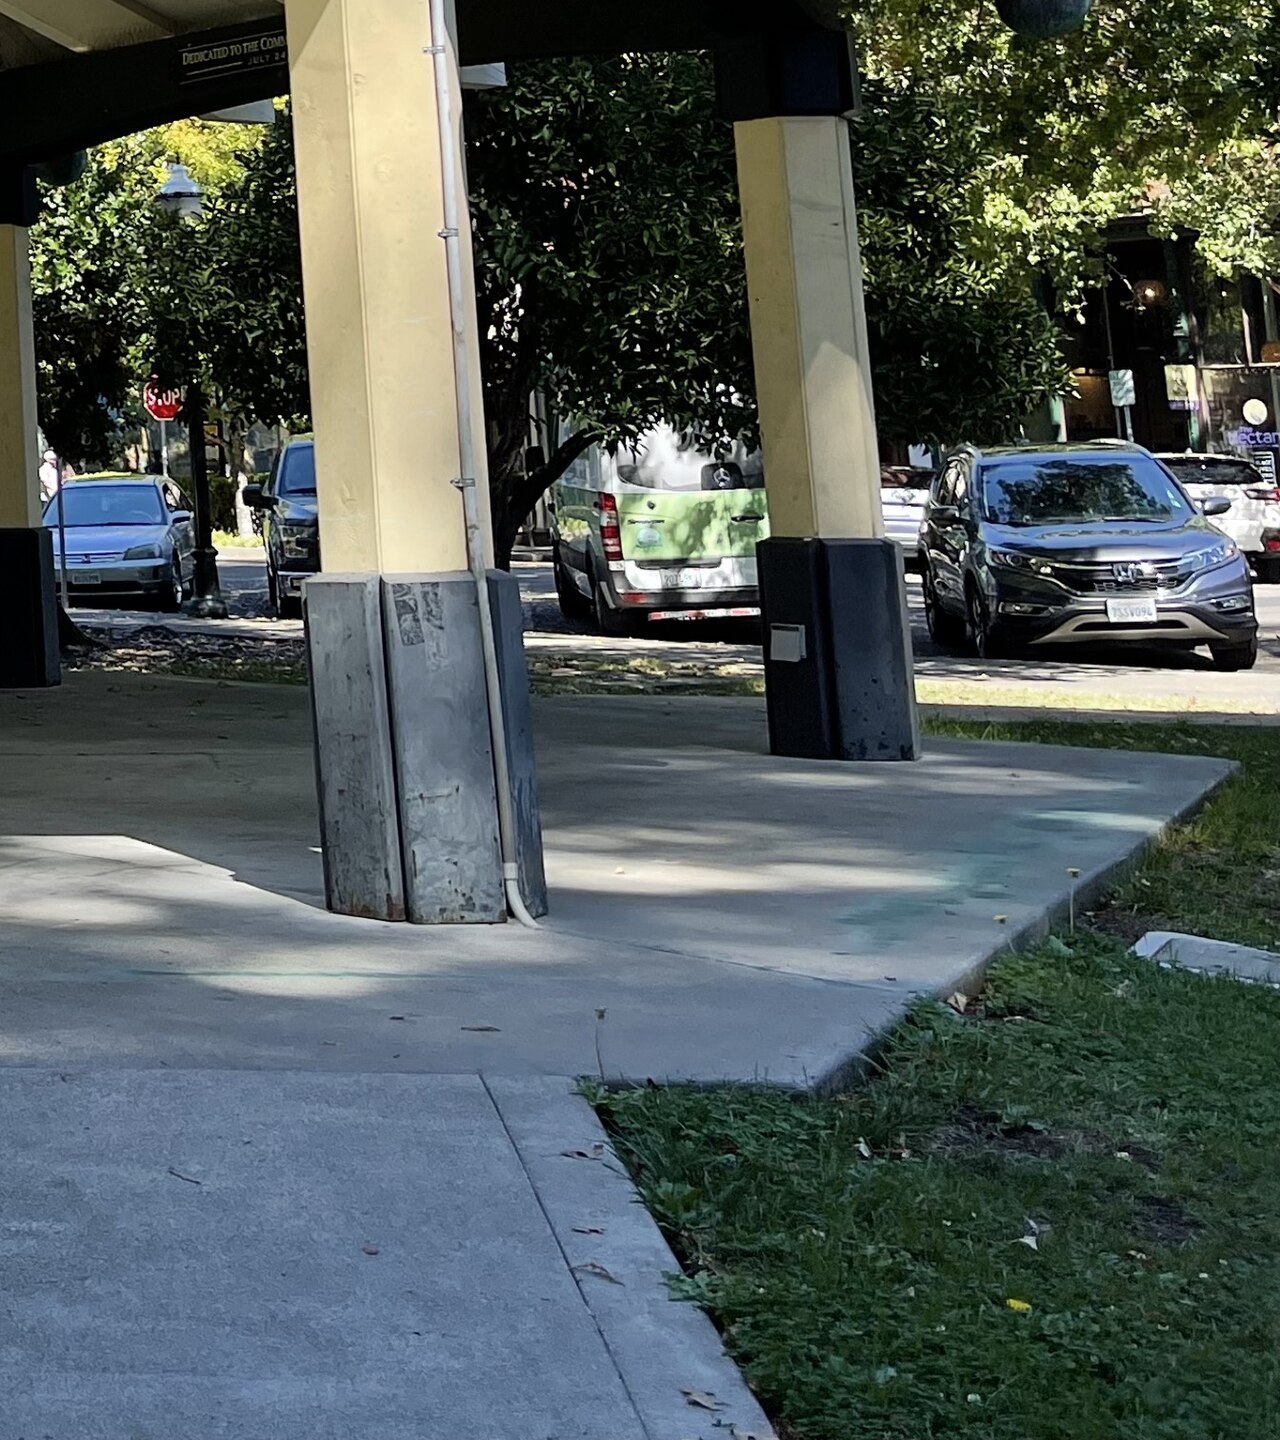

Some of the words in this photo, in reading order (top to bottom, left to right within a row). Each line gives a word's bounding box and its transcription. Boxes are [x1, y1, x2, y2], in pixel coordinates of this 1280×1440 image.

[182, 46, 229, 65] DEDICATED
[229, 44, 242, 56] TO
[242, 40, 259, 54] THE
[248, 54, 271, 65] JULY
